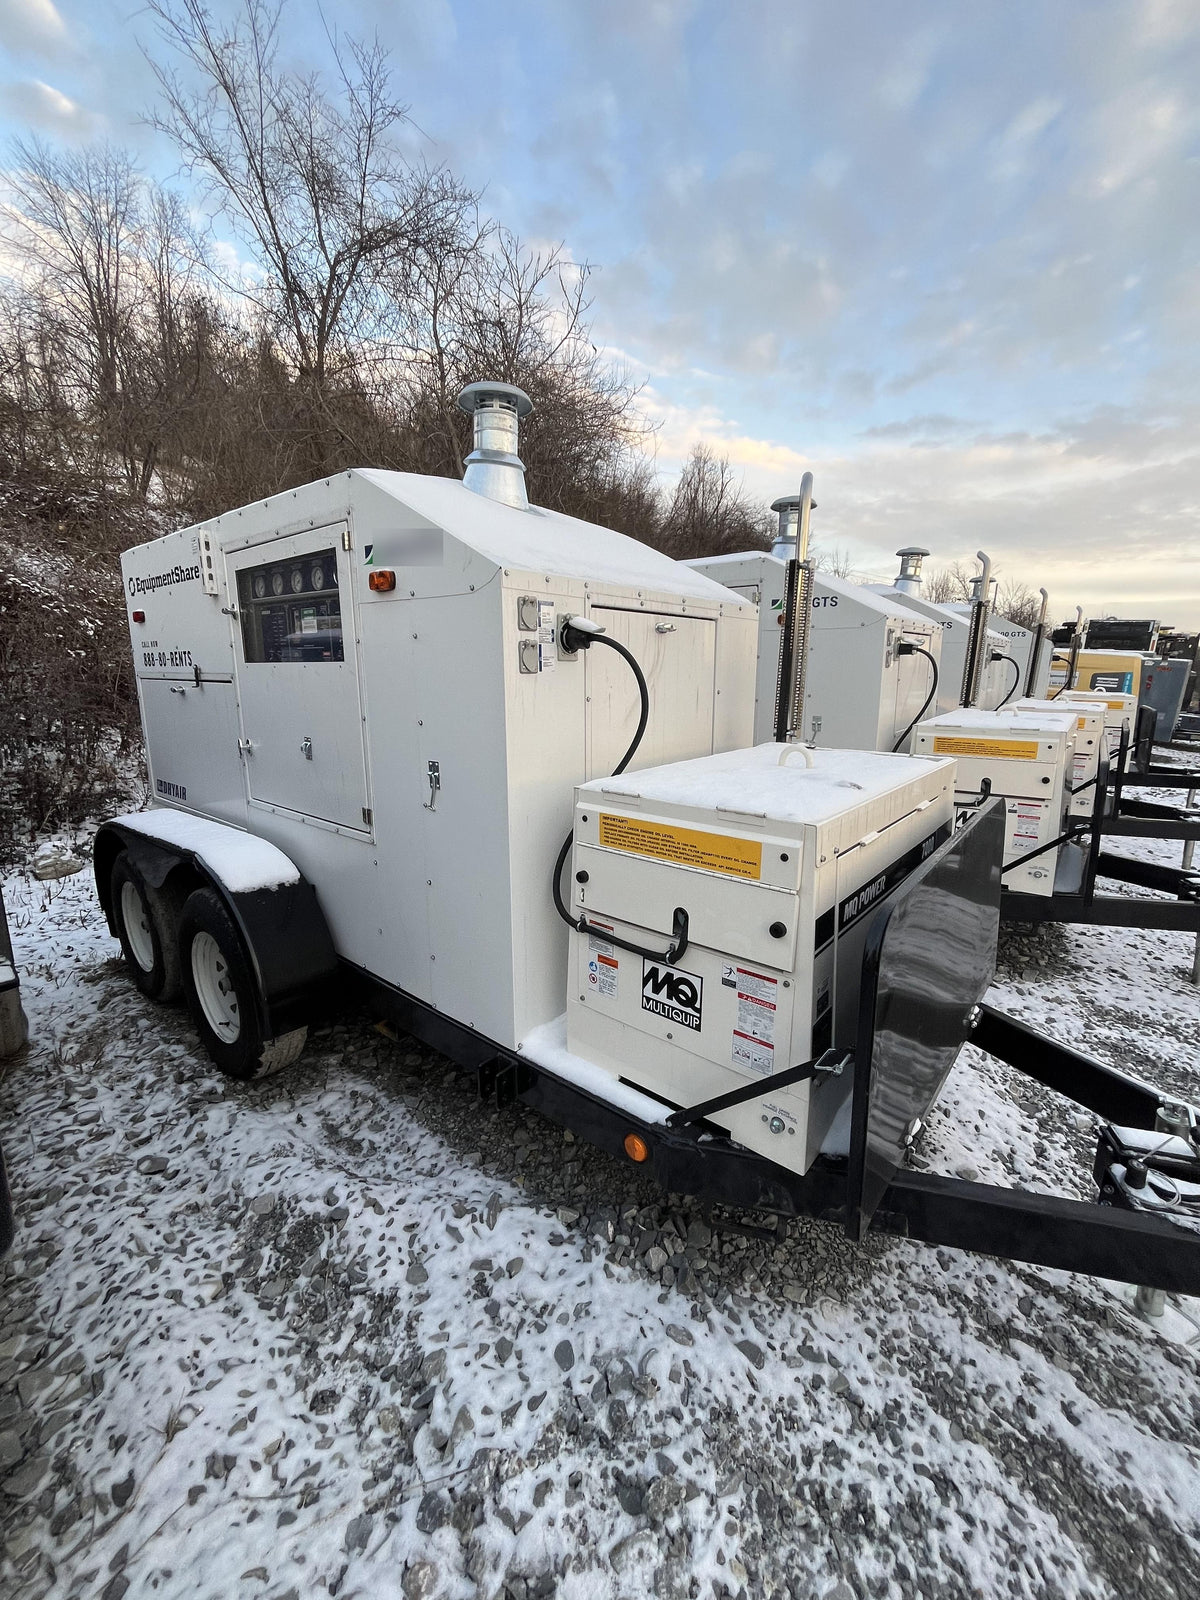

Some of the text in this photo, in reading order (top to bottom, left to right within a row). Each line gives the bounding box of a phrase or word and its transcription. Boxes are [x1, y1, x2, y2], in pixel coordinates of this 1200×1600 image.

[136, 566, 200, 594] EquipmentShare
[812, 596, 838, 608] GTS
[144, 651, 192, 667] 888-80-RENTS
[844, 876, 886, 922] MQ POWER
[642, 966, 700, 1016] MQ
[642, 996, 700, 1028] MULTIQUIP
